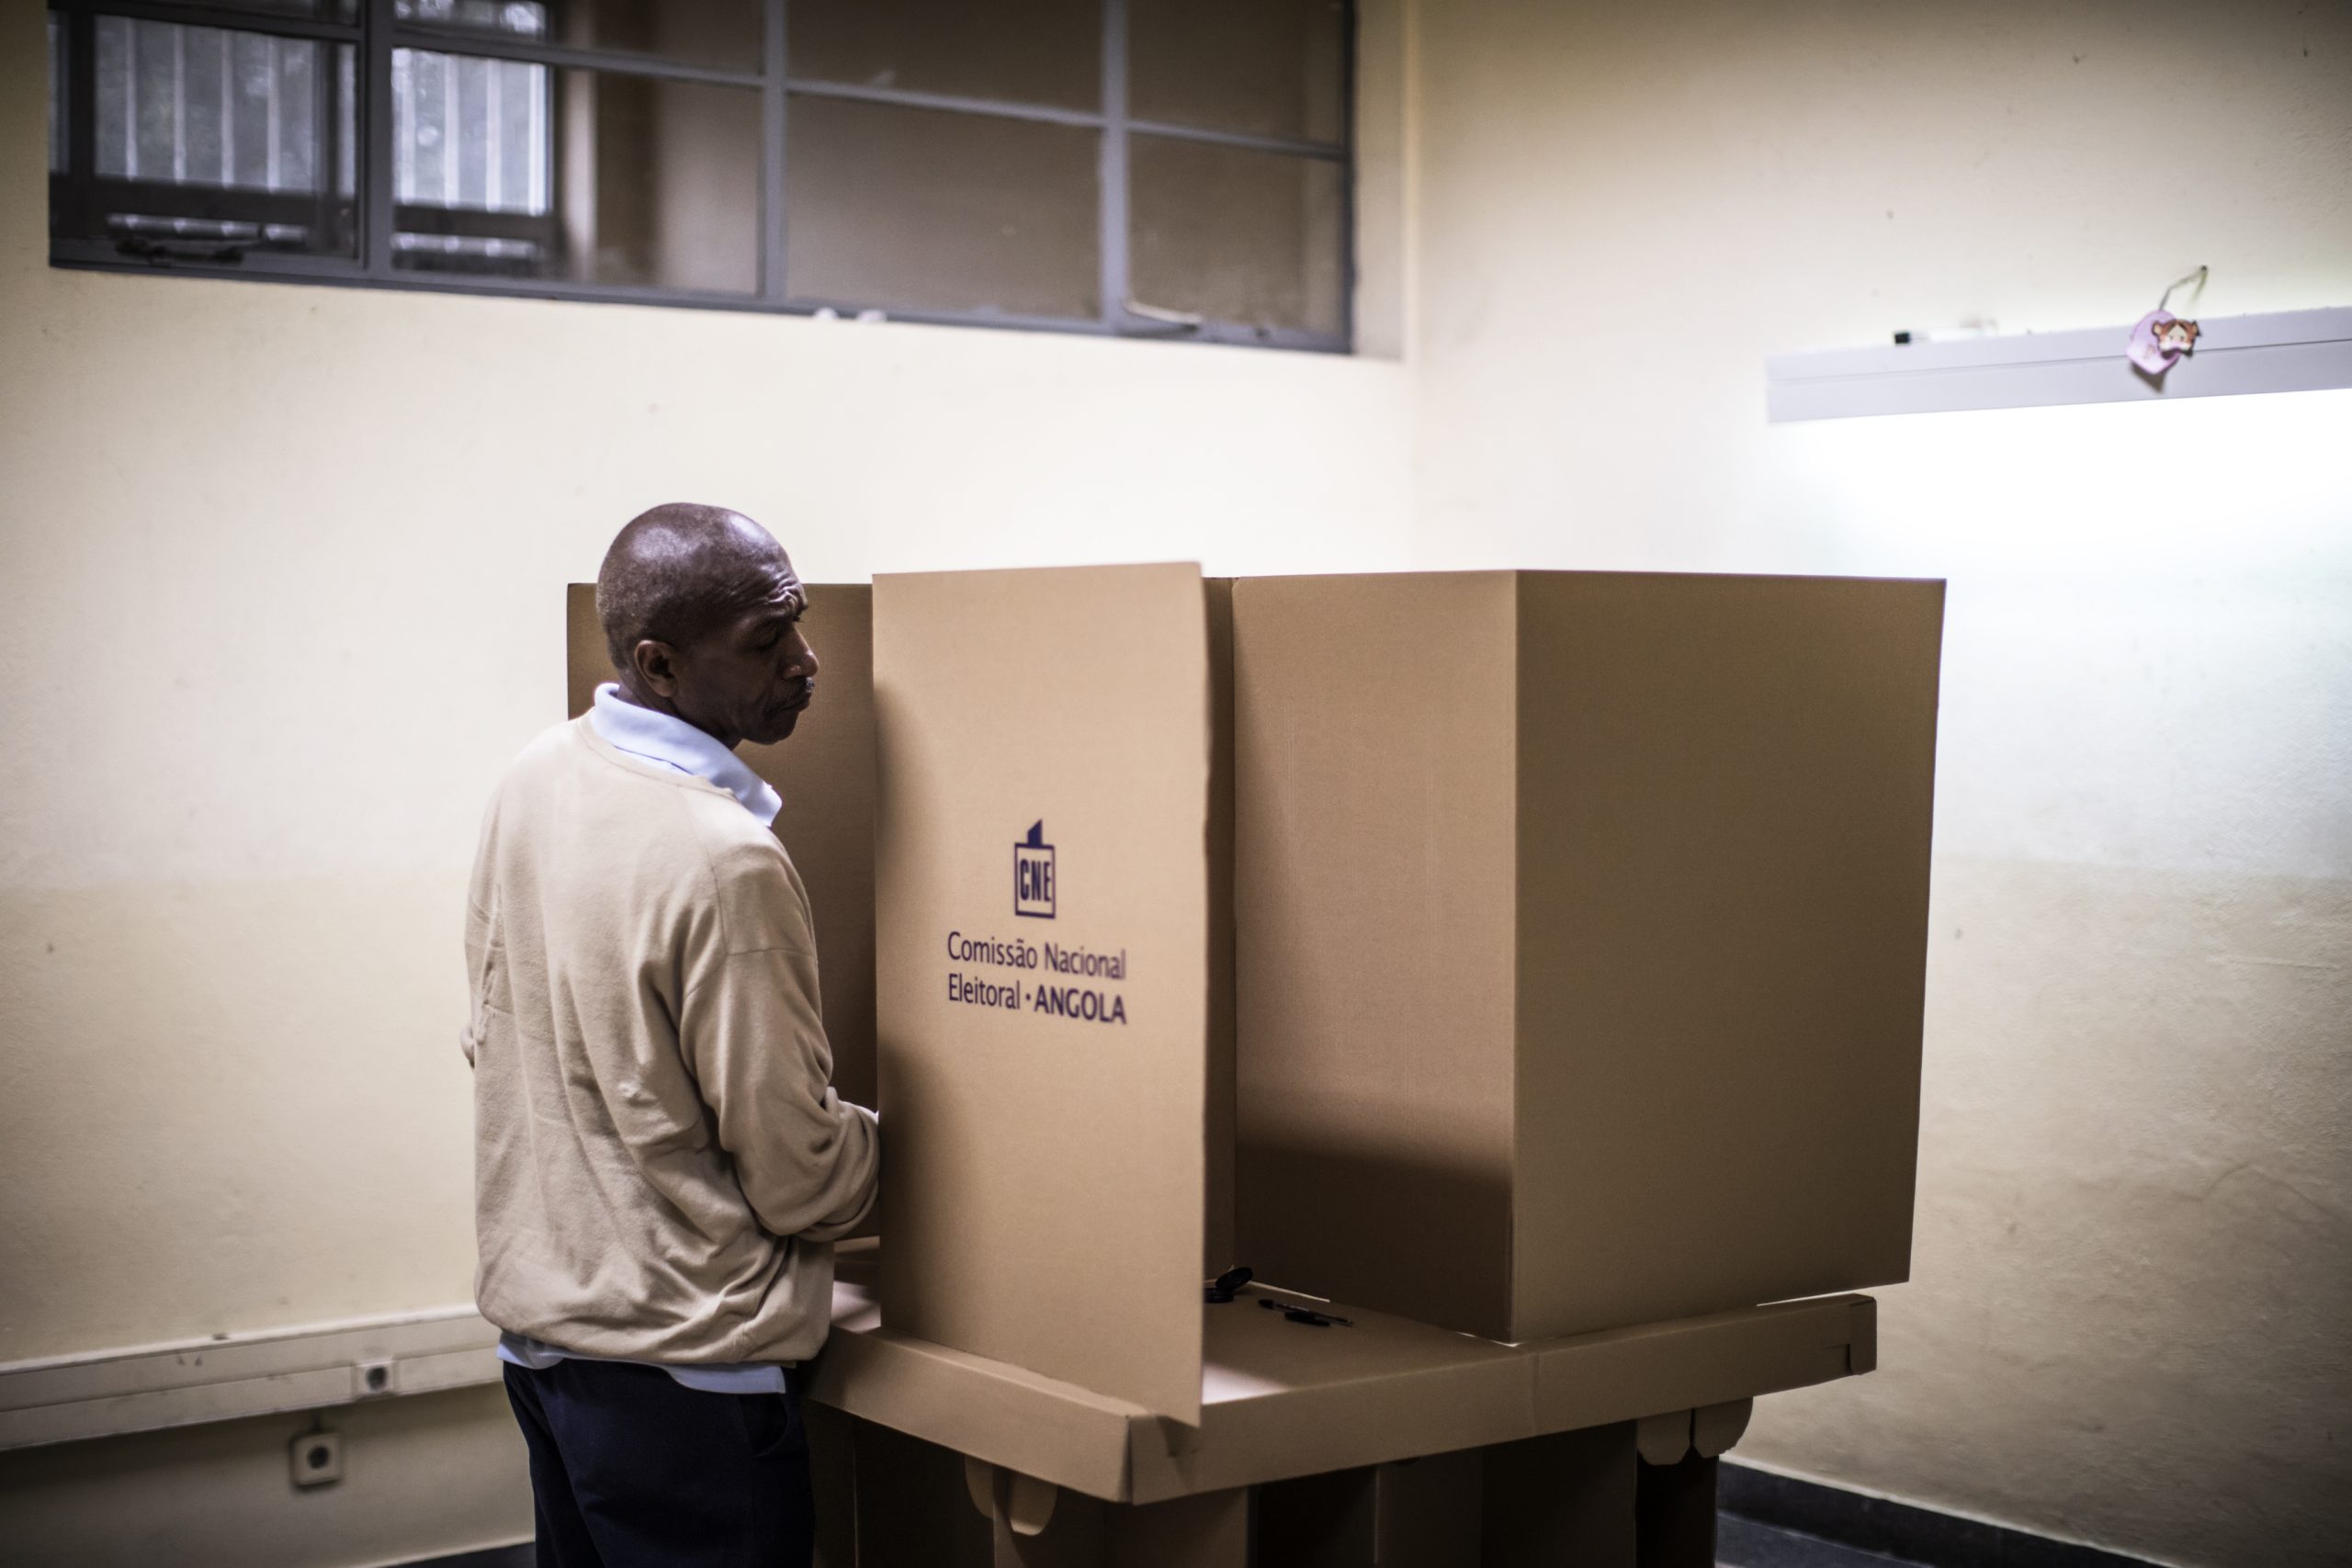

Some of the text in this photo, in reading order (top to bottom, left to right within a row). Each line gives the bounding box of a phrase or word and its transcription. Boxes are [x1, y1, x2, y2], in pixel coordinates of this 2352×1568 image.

[1020, 859, 1052, 902] CNE
[947, 931, 1126, 981] Comissão Nacional
[948, 973, 1127, 1025] Eleitoral ANGOLA
